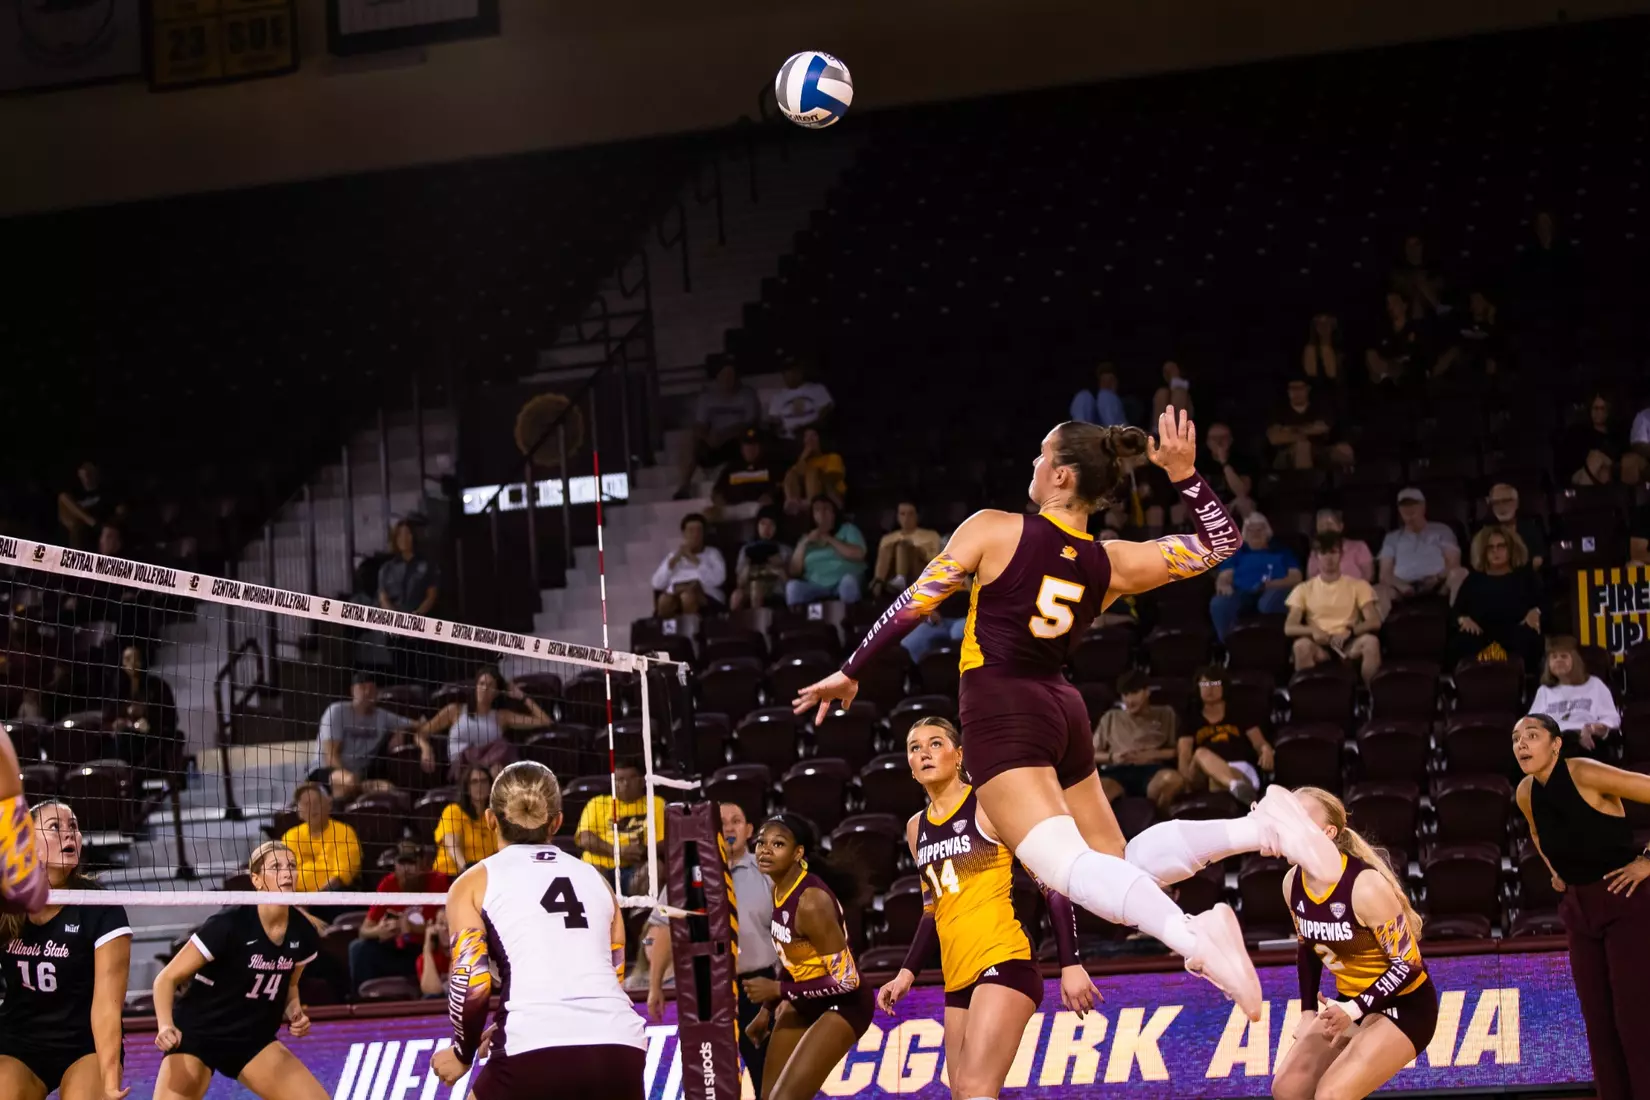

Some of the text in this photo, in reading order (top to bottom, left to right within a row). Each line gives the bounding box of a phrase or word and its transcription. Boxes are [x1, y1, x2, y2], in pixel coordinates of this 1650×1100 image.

[1195, 500, 1237, 568] CHIPPEWAS
[60, 549, 94, 572] CENTRAL
[95, 556, 134, 580] MICHIGAN
[134, 563, 177, 588] VOLLEYBALL
[211, 579, 241, 599] CENTRAL
[242, 584, 275, 605] MICHIGAN
[275, 590, 311, 612] VOLLEYBALL
[341, 603, 366, 622] CENTRAL
[366, 608, 395, 627] MICHIGAN
[394, 613, 426, 632] VOLLEYBALL
[451, 623, 473, 640] CENTRAL
[473, 628, 498, 646] MICHIGAN
[498, 632, 526, 650] VOLLEYBALL
[1028, 575, 1086, 639] 5
[1593, 582, 1650, 615] FIRE
[1608, 620, 1643, 652] UP
[926, 858, 960, 898] 14
[540, 876, 589, 929] 4
[6, 938, 70, 958] Illinois State
[248, 953, 294, 970] Illinois State
[1314, 943, 1346, 971] 2
[17, 960, 58, 992] 16
[245, 973, 283, 1001] 14
[1205, 988, 1520, 1079] ANA
[699, 1041, 716, 1086] sports
